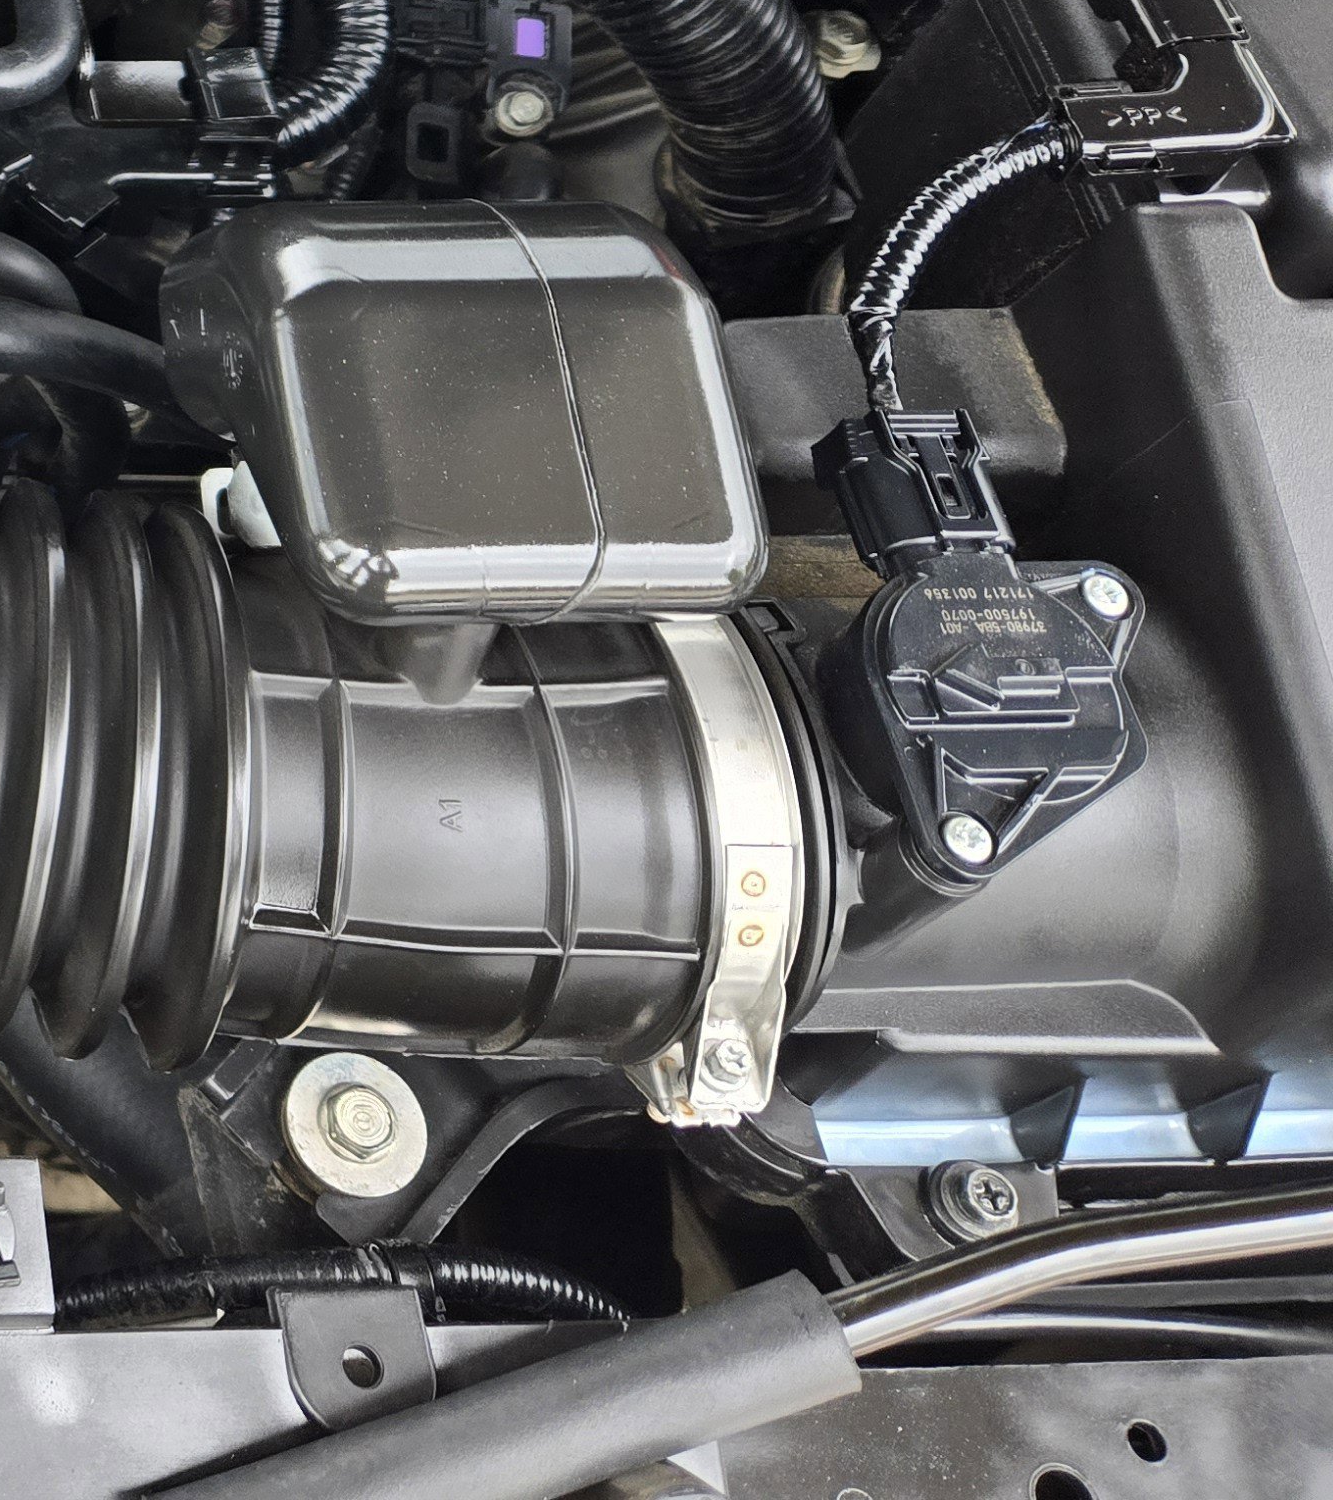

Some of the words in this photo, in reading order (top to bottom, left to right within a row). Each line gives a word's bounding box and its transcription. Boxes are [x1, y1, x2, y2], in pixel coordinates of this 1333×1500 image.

[1100, 105, 1188, 129] >PP<
[923, 586, 977, 601] 001356
[983, 586, 1035, 601] 171217
[438, 798, 463, 833] A1
